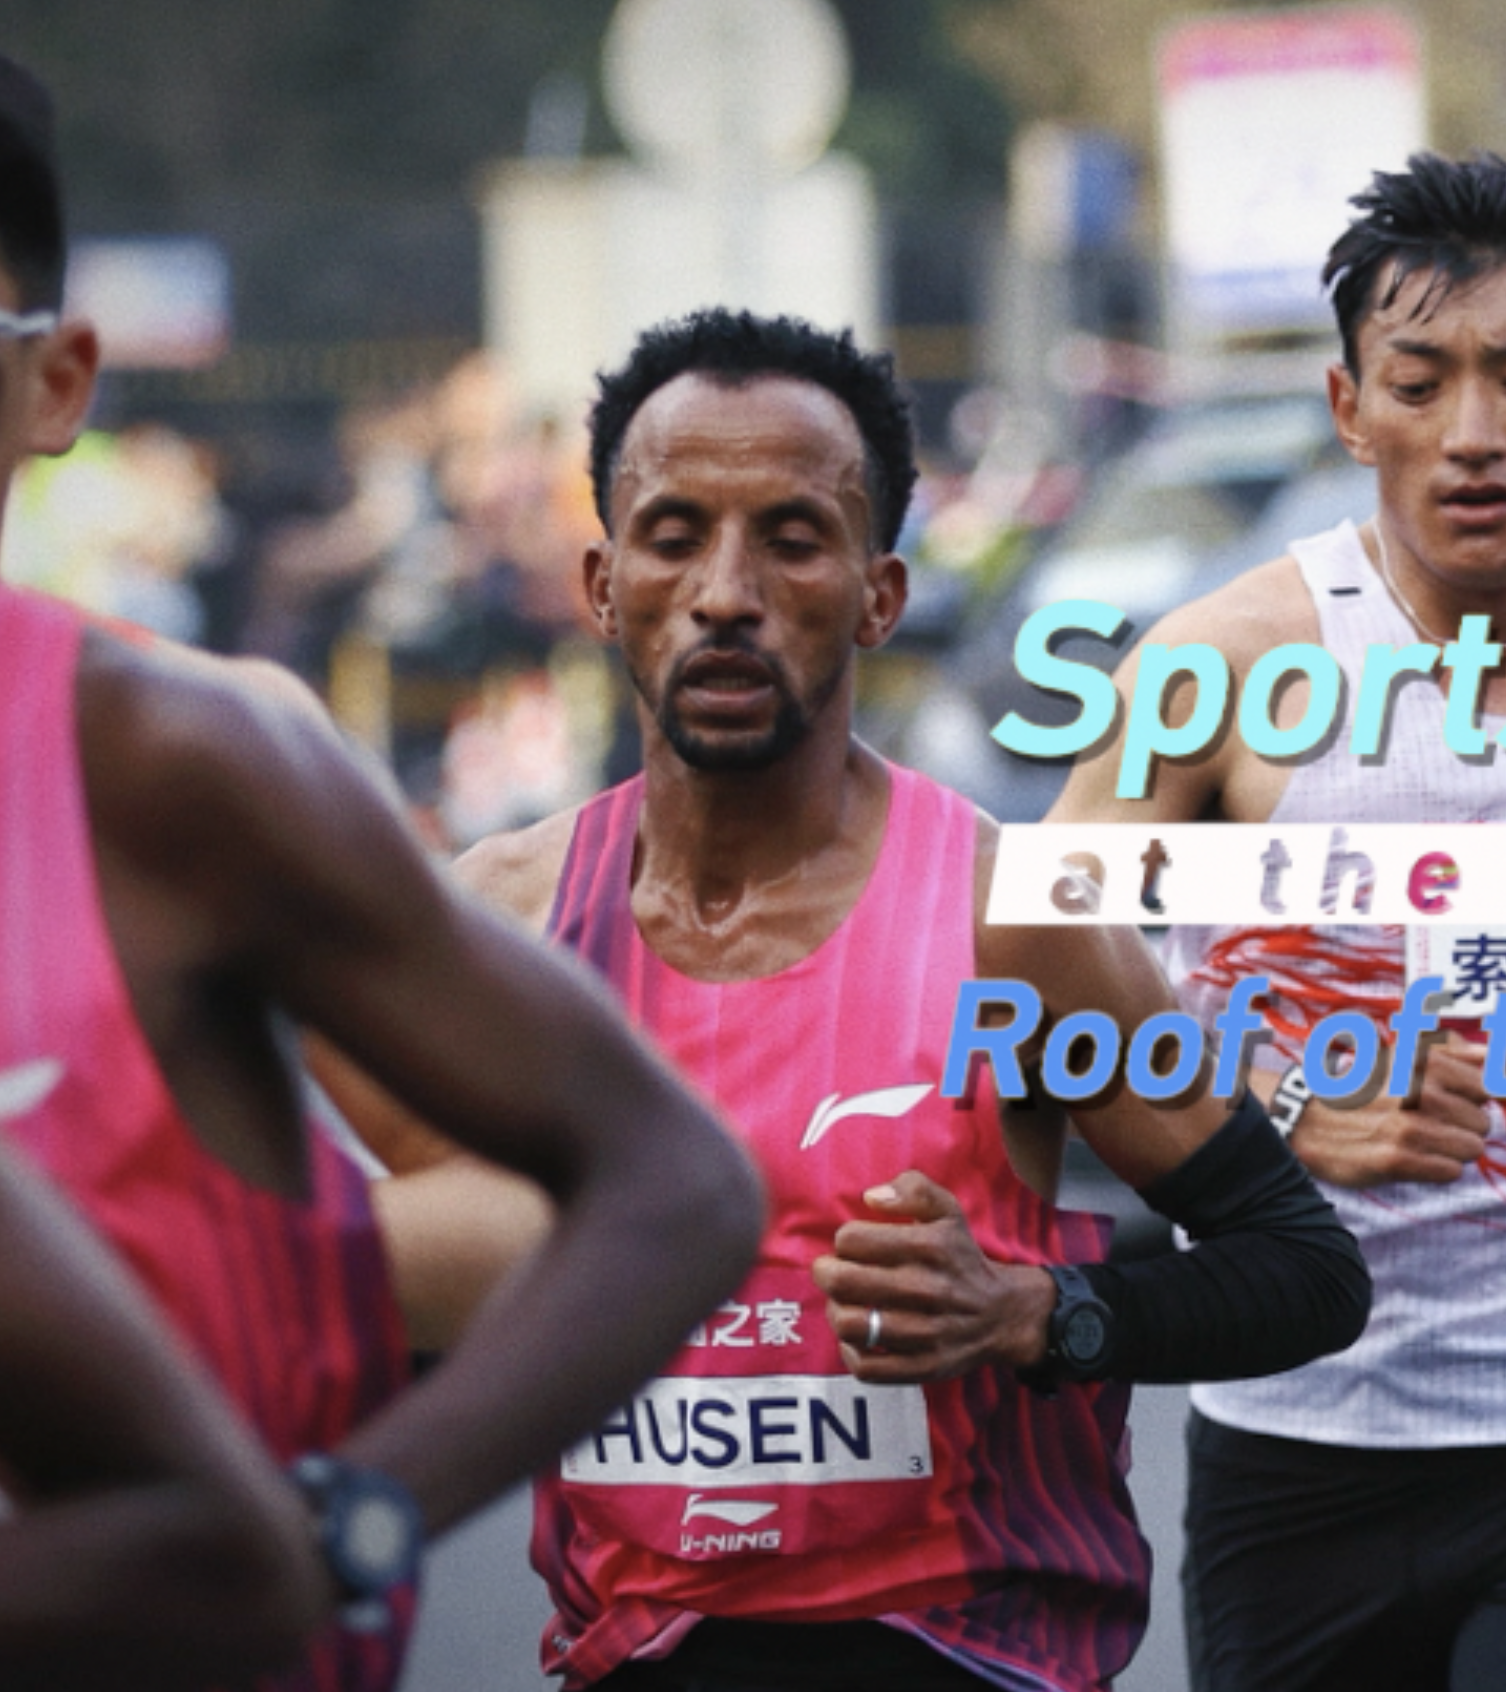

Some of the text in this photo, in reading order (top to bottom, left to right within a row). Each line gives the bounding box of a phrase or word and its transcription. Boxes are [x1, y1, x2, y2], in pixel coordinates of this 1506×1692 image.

[688, 1299, 802, 1347] 之家
[595, 1396, 871, 1469] HUSEN
[909, 1455, 924, 1474] 3
